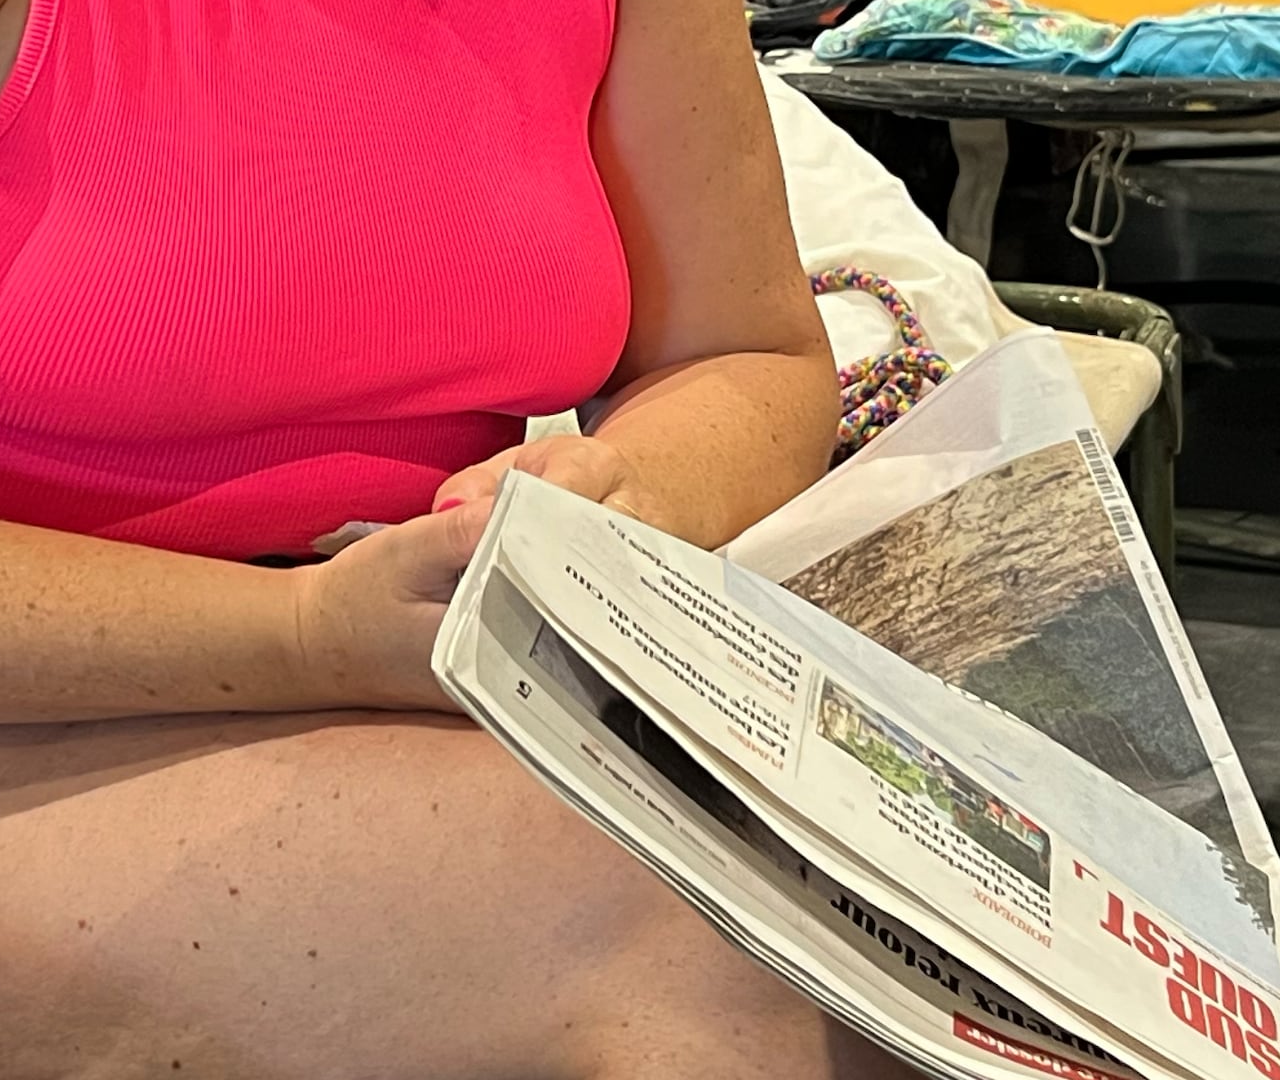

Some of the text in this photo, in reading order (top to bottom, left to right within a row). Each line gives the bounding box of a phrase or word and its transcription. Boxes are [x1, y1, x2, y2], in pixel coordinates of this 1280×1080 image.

[628, 537, 729, 610] entreprises
[638, 574, 796, 693] Les conséquences
[658, 573, 800, 679] des évacuations
[732, 610, 759, 635] les
[564, 563, 789, 742] centre antipoison du CHU
[760, 631, 802, 664] pour
[516, 680, 532, 699] 5
[606, 615, 786, 757] Les bons conseils du
[877, 808, 910, 834] des
[902, 798, 939, 830] l'été
[878, 793, 1051, 917] principaux travaux
[951, 830, 966, 844] de
[971, 845, 1022, 886] voirie
[1008, 897, 1052, 931] Tour
[1029, 884, 1049, 902] de
[972, 886, 1051, 949] BORDEAUX
[829, 892, 961, 995] retour
[1099, 891, 1276, 1041] OUEST
[966, 1029, 1072, 1073] dossier
